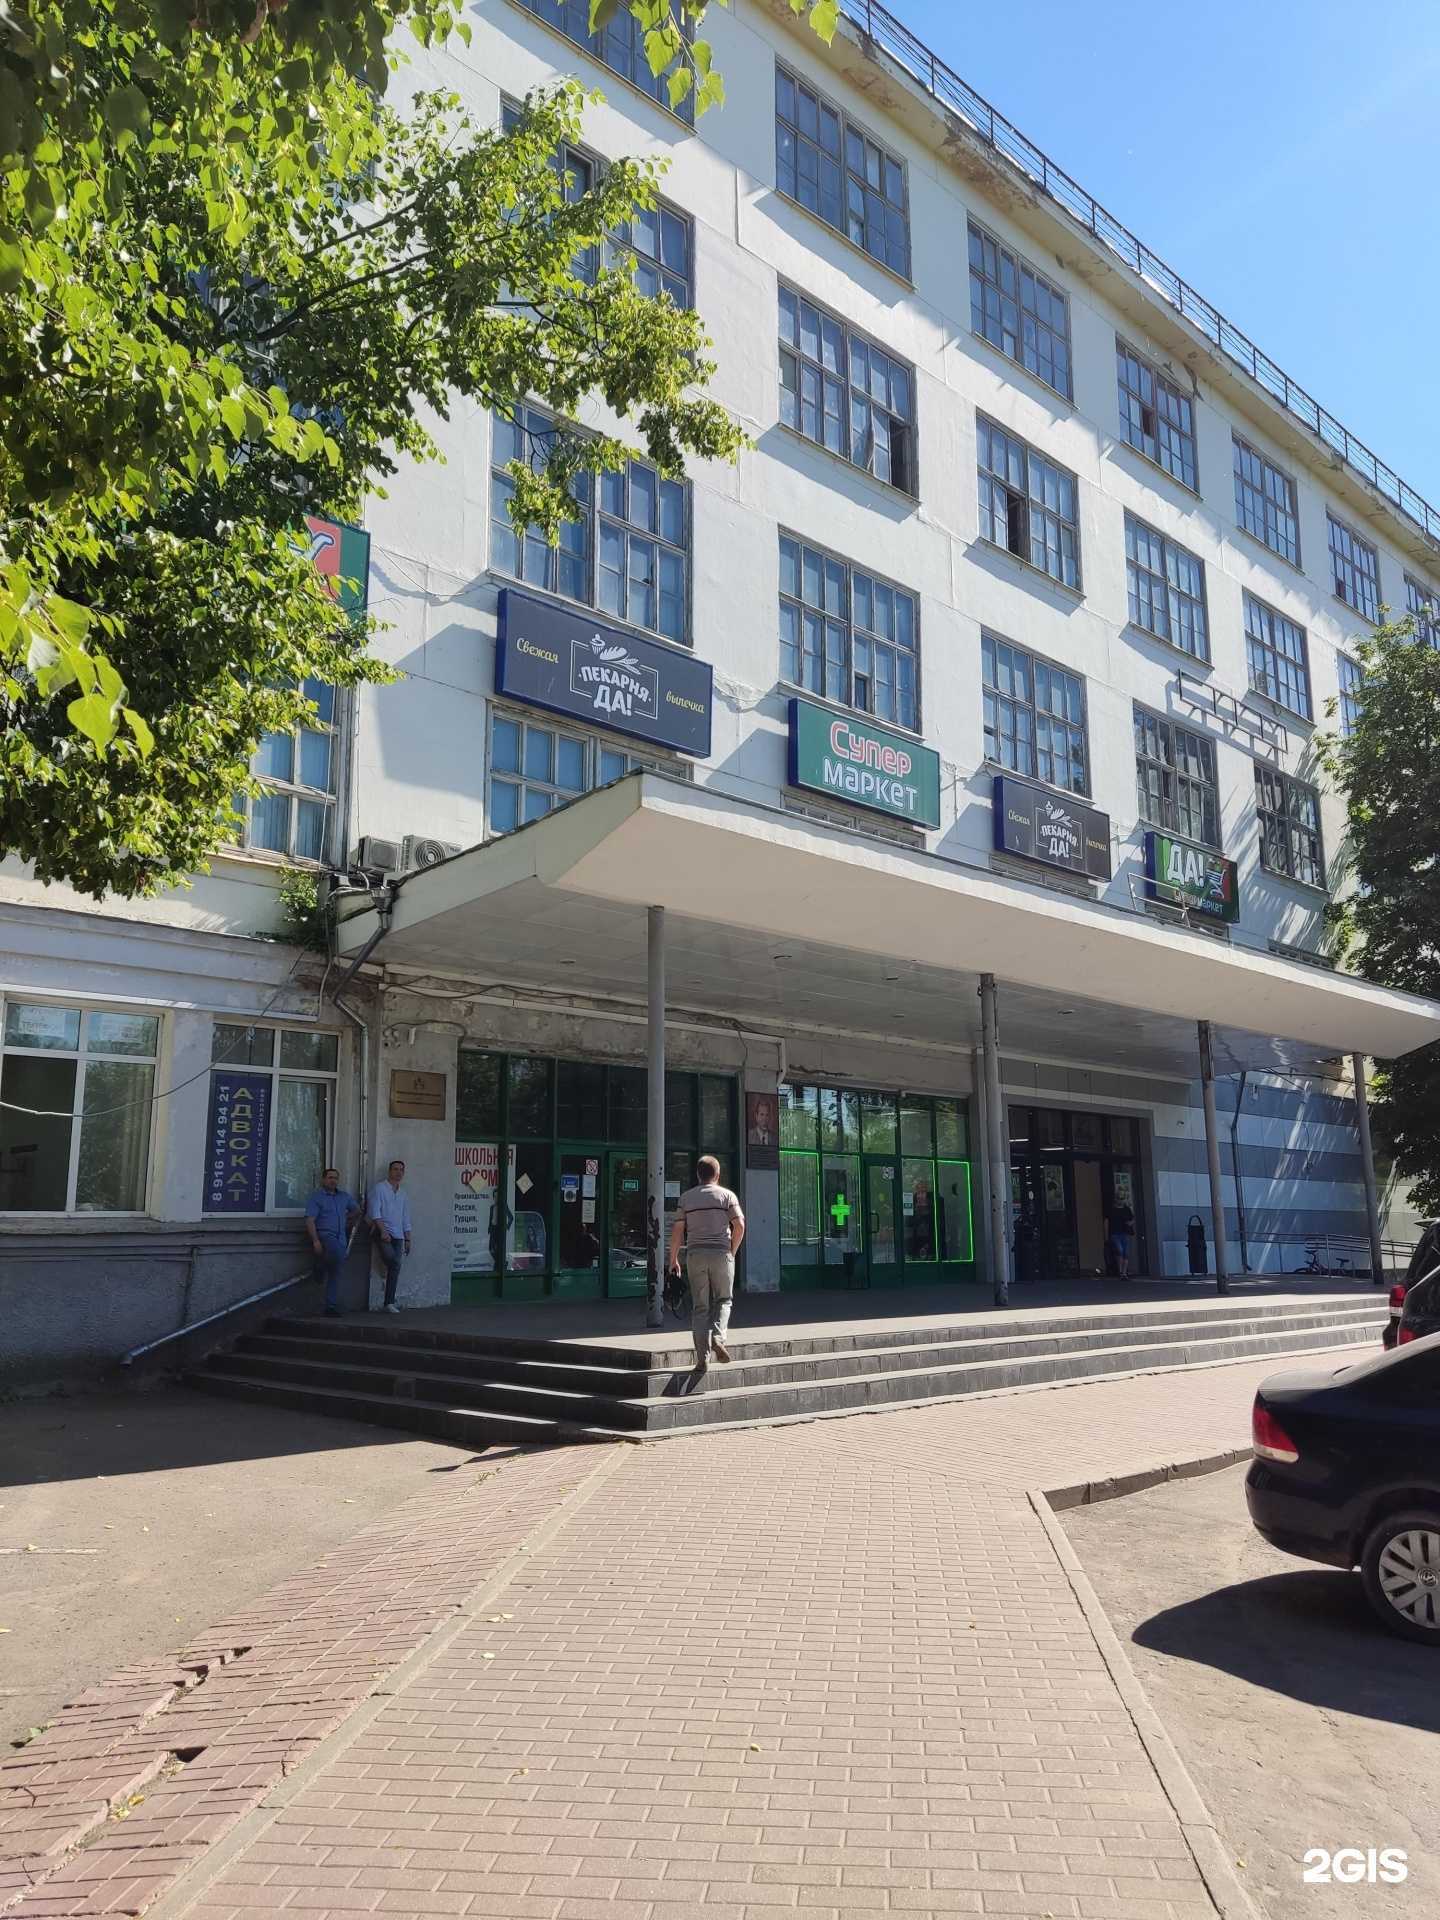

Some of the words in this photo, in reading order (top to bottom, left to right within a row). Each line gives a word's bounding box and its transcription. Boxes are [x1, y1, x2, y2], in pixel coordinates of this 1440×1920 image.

[516, 637, 559, 664] Свежая
[580, 666, 650, 702] ПЕКАРНЯ
[593, 685, 632, 716] ДА!
[665, 690, 705, 714] выпечка
[831, 721, 911, 777] Супер
[824, 757, 917, 810] Маркет
[1041, 823, 1078, 847] ПЕКАРНЯ
[1048, 837, 1070, 858] ДА!
[1168, 844, 1205, 888] ДА!
[219, 1086, 230, 1102] 21
[218, 1107, 229, 1125] 94
[216, 1129, 227, 1156] 114
[226, 1087, 254, 1202] АДВОКАТ
[455, 1147, 514, 1166] ШКОЛЬНЯ
[213, 1160, 225, 1188] 916
[461, 1168, 499, 1187] ФРМ
[212, 1192, 222, 1202] 8
